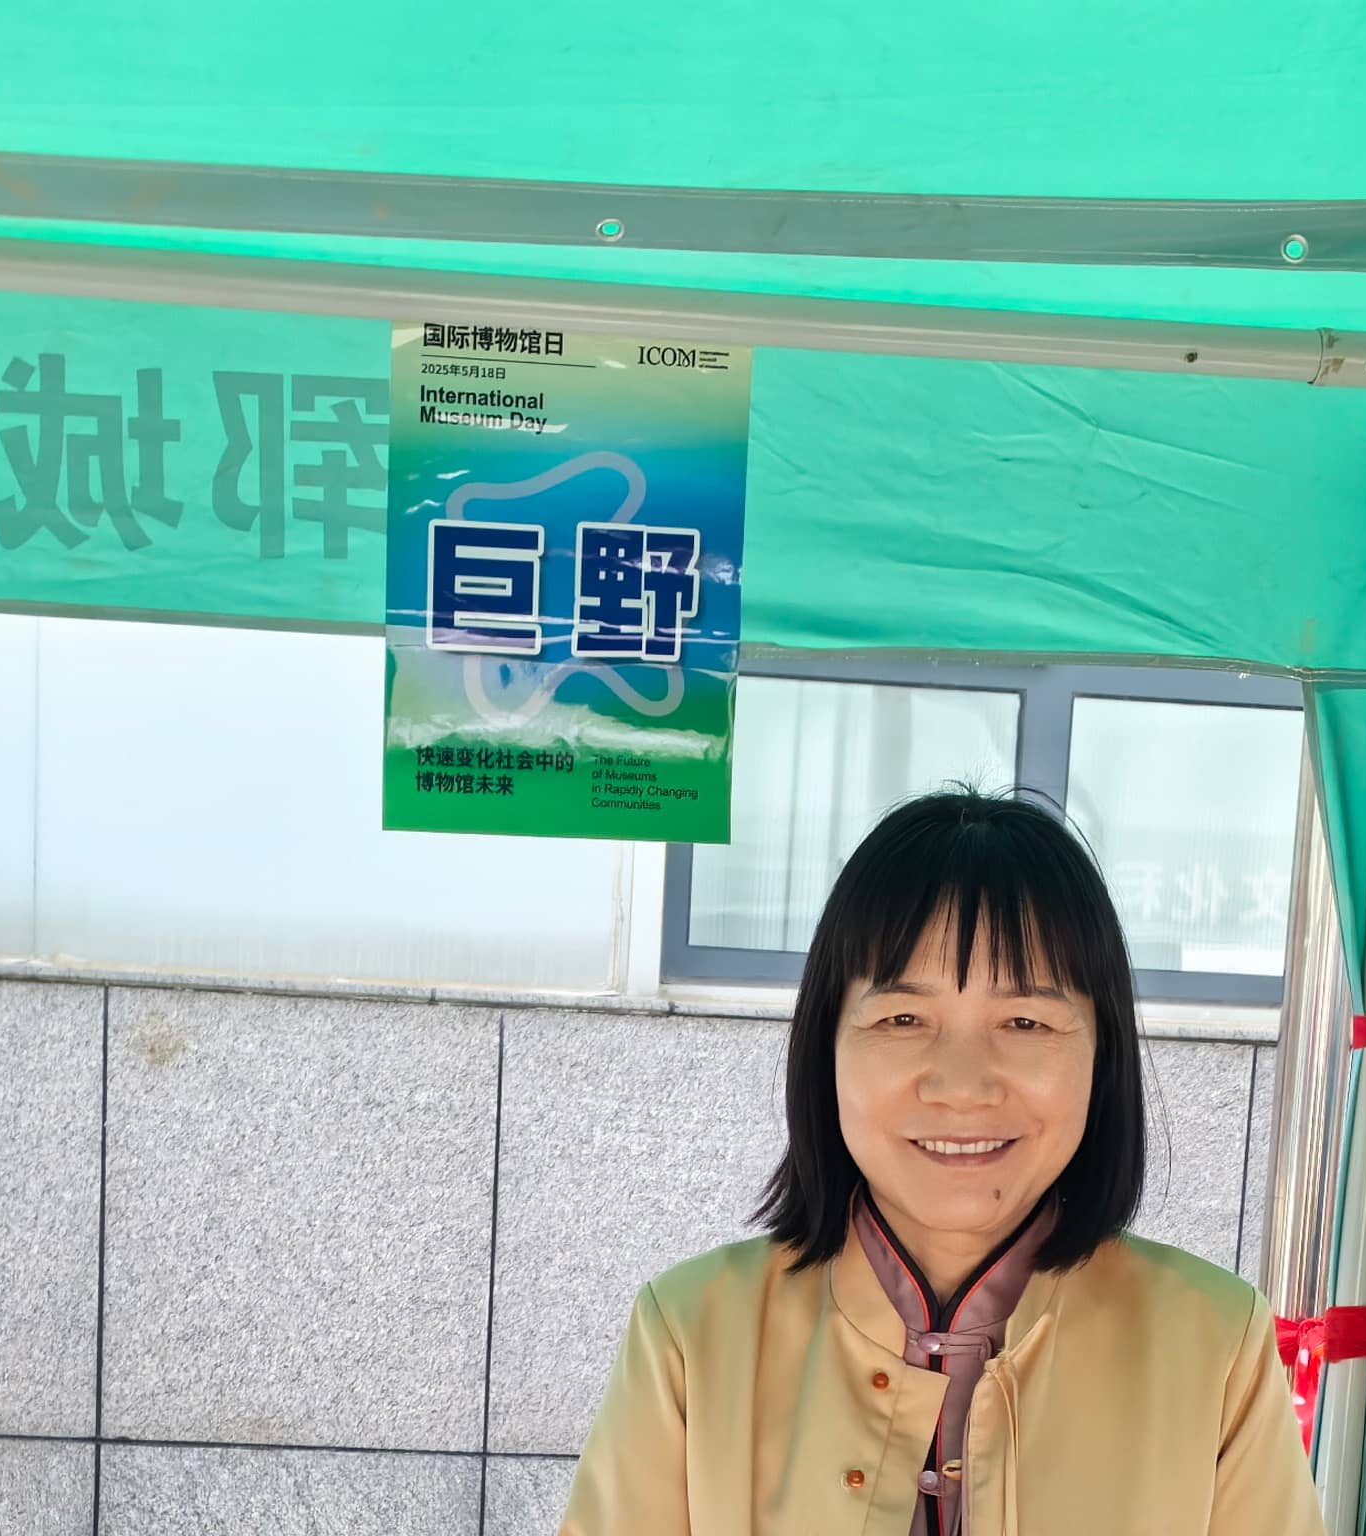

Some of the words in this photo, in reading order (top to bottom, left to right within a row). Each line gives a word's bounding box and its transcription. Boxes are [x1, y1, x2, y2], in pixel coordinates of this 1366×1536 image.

[422, 322, 564, 357] 国际博物馆日
[637, 346, 696, 368] ICOM
[421, 363, 506, 380] 2025年5月18日
[420, 385, 544, 410] International
[420, 405, 503, 428] Museum
[510, 411, 547, 434] Day
[428, 519, 700, 662] 巨野
[416, 746, 575, 773] 快速变化社会中的
[593, 755, 612, 767] The
[616, 755, 651, 768] Future
[415, 771, 514, 796] 博物馆未来
[592, 768, 603, 780] of
[605, 769, 657, 782] Museums
[592, 783, 601, 794] in
[604, 784, 644, 798] Rapidly
[647, 785, 698, 800] Changing
[592, 798, 661, 811] Communities
